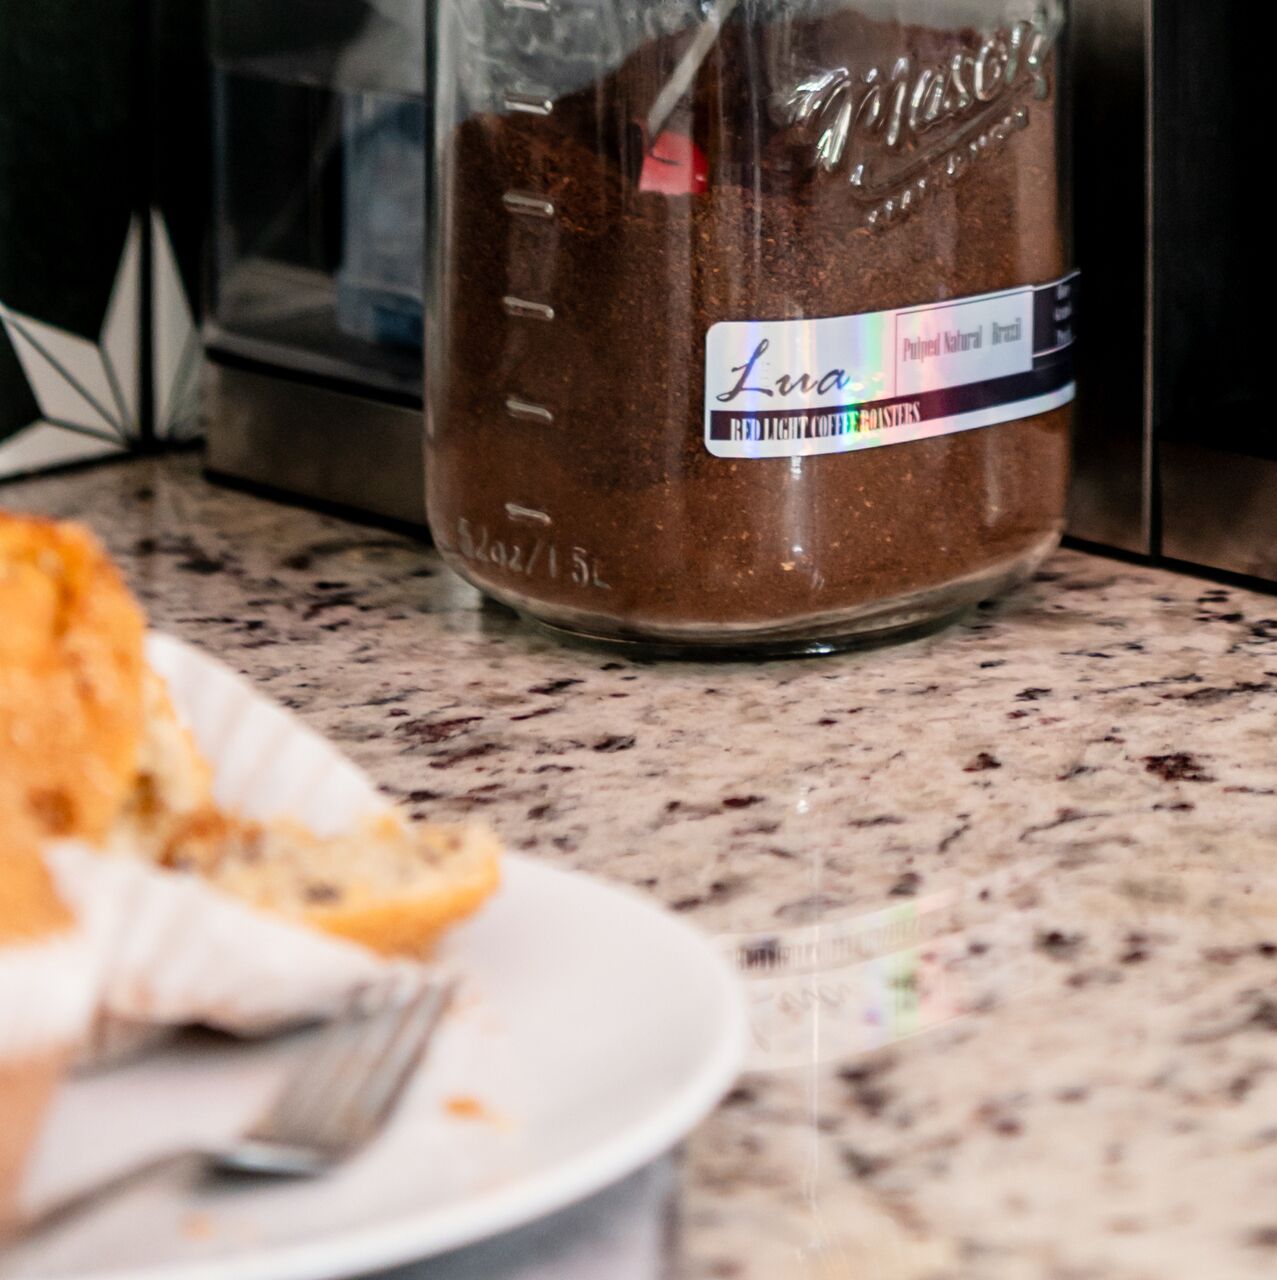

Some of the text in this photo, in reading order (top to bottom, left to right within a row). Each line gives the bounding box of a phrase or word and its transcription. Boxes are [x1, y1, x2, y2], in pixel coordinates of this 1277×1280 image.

[903, 317, 1022, 363] Pulped Natural Brazil
[715, 338, 851, 403] Lua
[730, 401, 921, 441] RED LIGHT COFFEE ROASTERS
